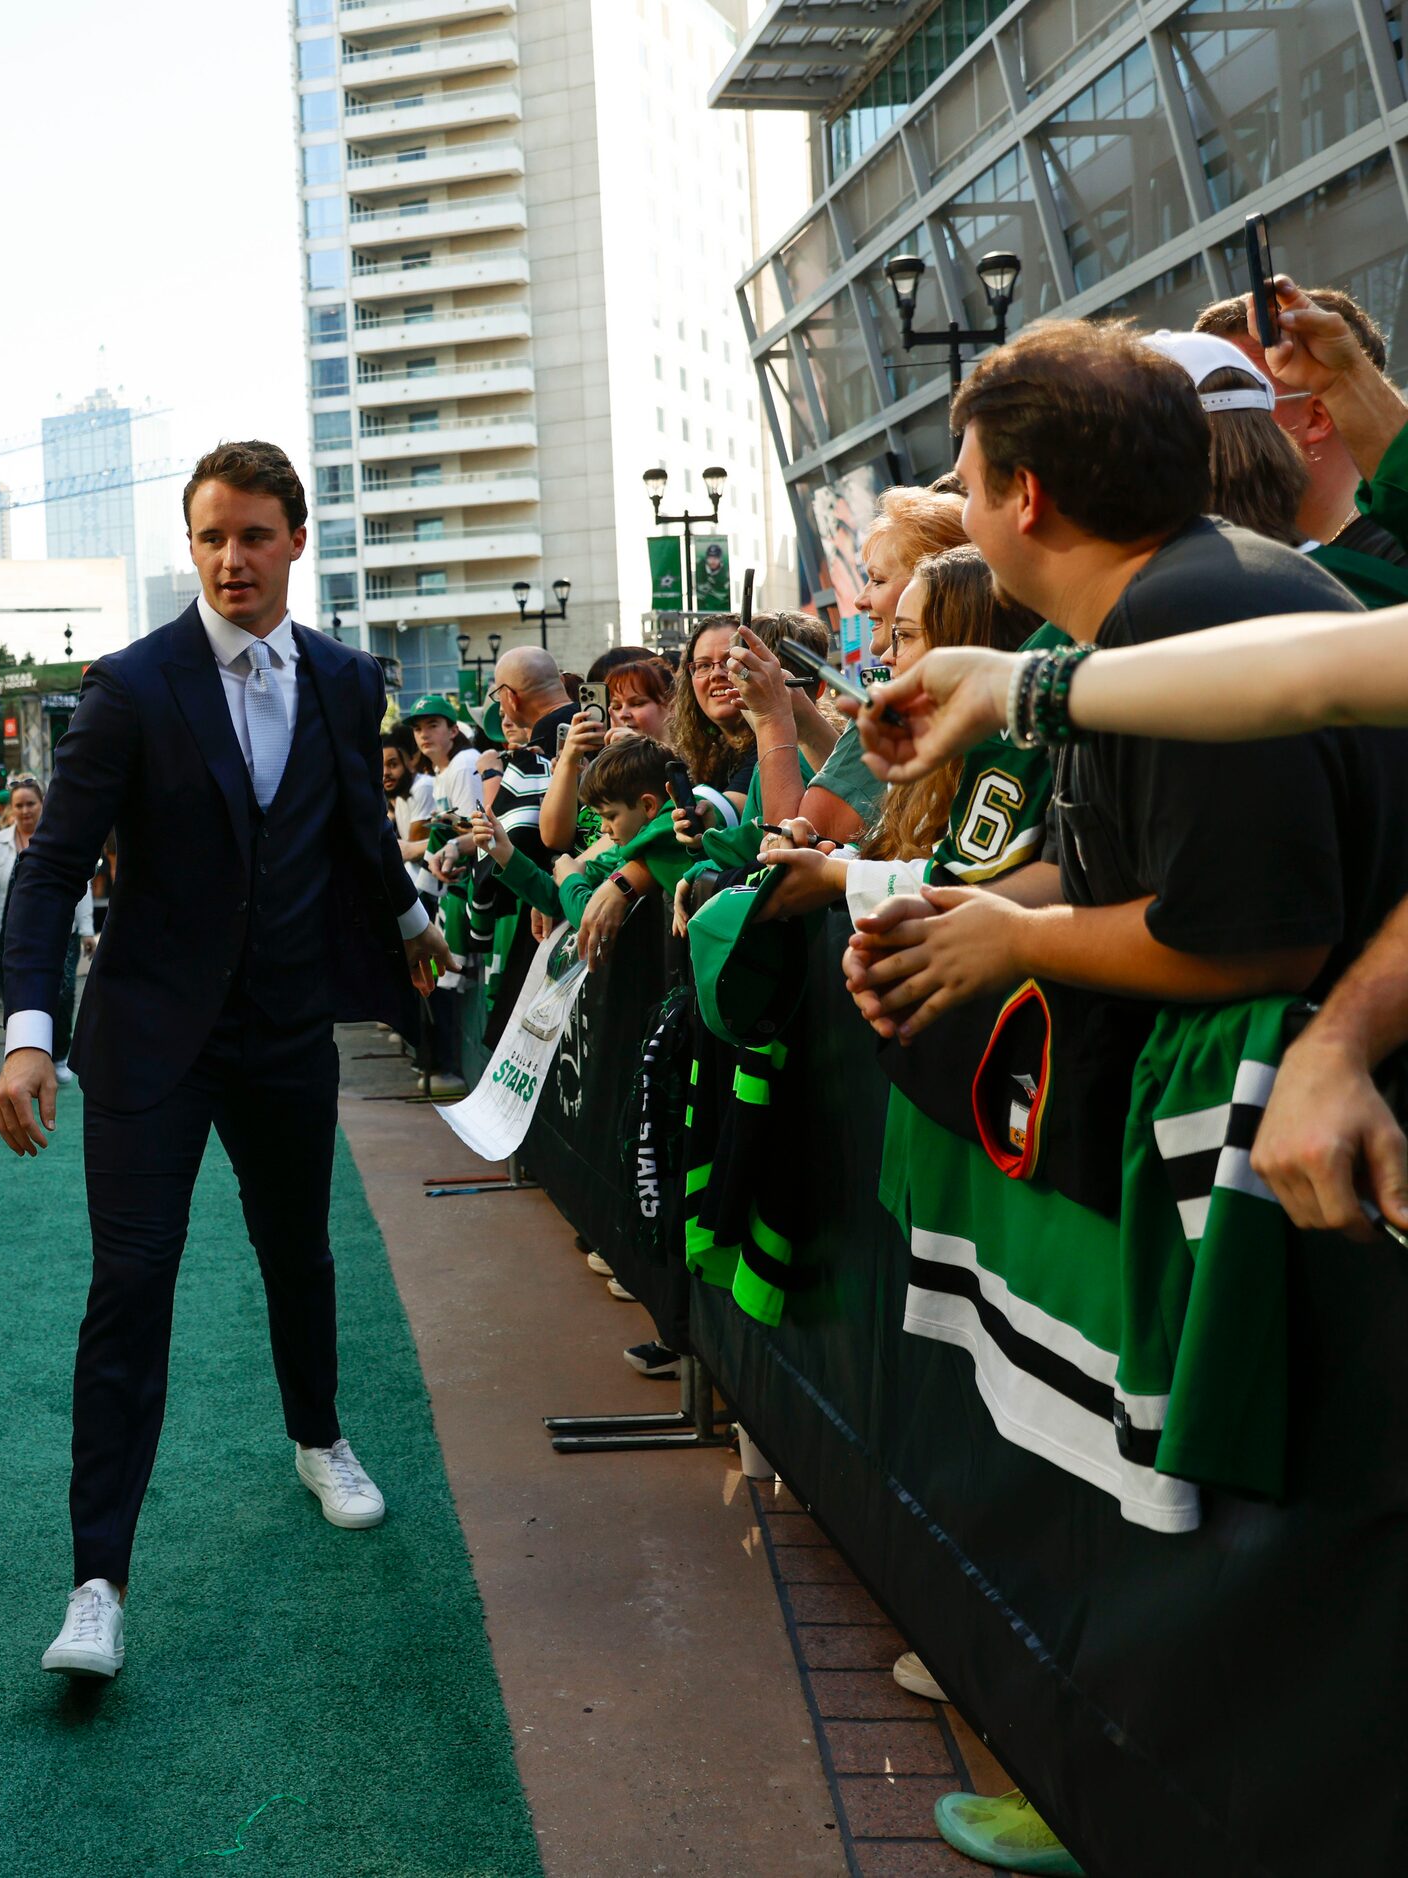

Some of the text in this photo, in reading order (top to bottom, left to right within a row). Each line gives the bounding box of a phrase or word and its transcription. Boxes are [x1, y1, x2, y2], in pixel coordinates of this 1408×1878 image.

[956, 767, 1026, 865] 6
[492, 1059, 538, 1103] STARS
[510, 1050, 539, 1073] DALLAS
